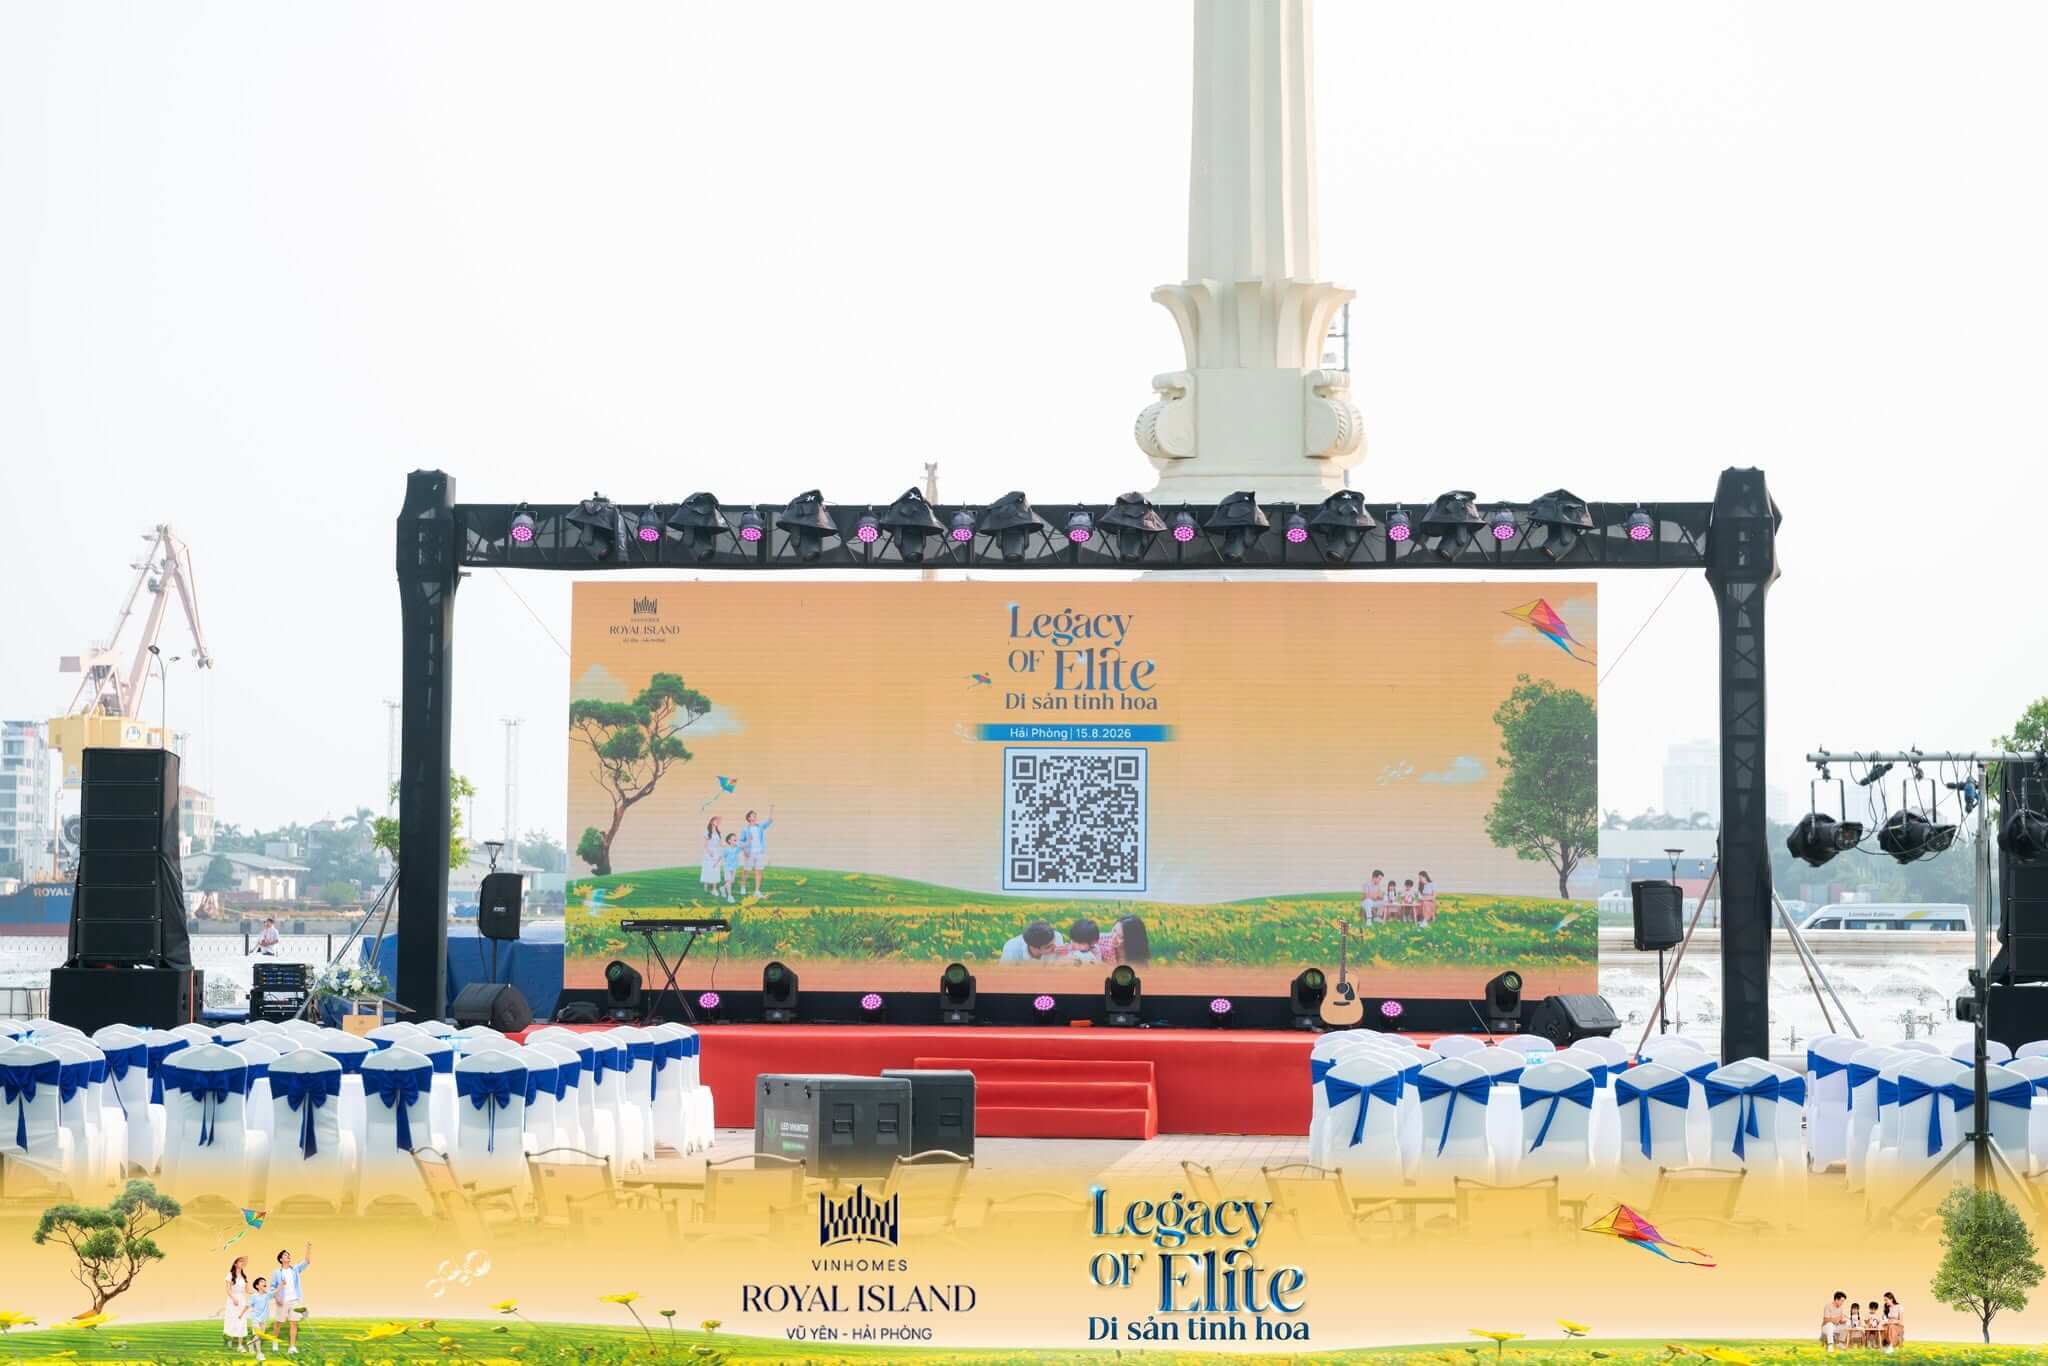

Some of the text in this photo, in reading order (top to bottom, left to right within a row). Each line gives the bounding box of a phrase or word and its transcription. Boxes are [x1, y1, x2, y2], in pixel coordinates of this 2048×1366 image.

[609, 625, 680, 635] ROYAL ISLAND
[1008, 604, 1135, 647] Legacy
[1008, 647, 1157, 691] OF Elite
[1005, 693, 1026, 710] Di
[1073, 693, 1114, 710] tinh
[1120, 693, 1158, 710] hoa
[1031, 727, 1068, 741] Phòng
[1076, 728, 1132, 739] 15.8.2026
[33, 887, 72, 897] ROYAL
